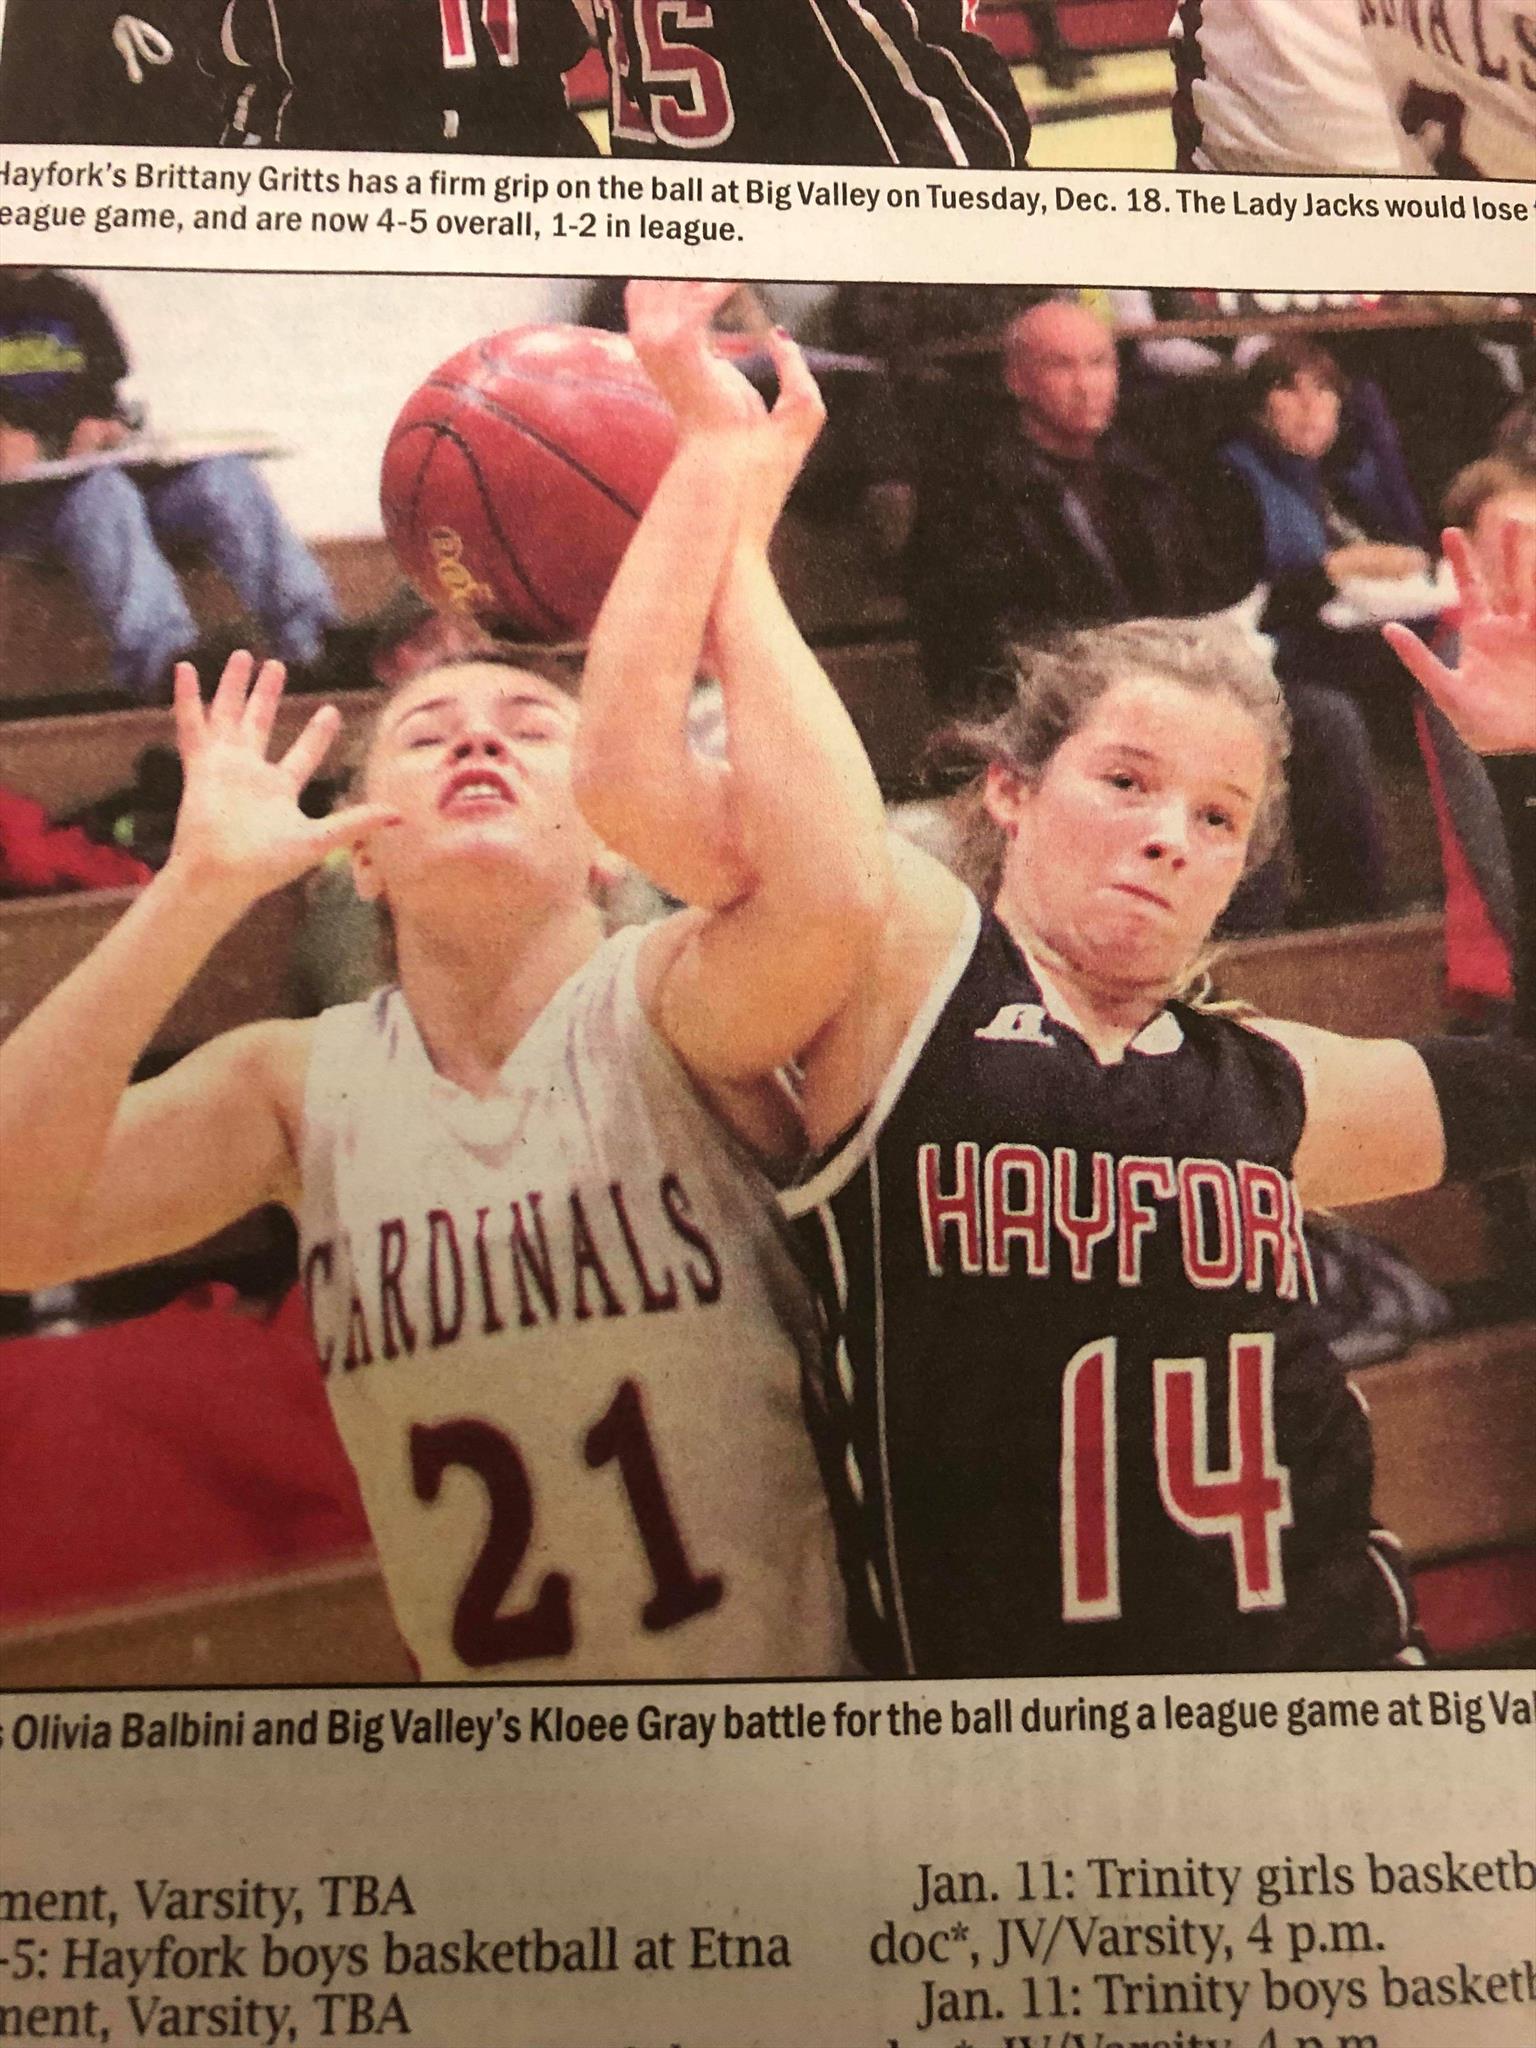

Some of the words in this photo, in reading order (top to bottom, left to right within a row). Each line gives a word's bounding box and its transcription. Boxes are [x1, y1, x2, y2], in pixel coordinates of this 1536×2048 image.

[135, 162, 252, 197] Brittany
[258, 165, 340, 193] Gritts
[348, 167, 399, 195] has
[405, 175, 422, 195] a
[429, 169, 486, 197] firm
[493, 172, 549, 204] grip
[556, 179, 591, 199] on
[597, 174, 644, 201] the
[651, 175, 703, 202] ball
[710, 180, 740, 204] at
[746, 179, 792, 212] Big
[796, 180, 881, 213] Valley
[886, 188, 920, 209] on
[925, 183, 1047, 217] Tuesday,
[1055, 186, 1117, 212] Dec.
[1127, 187, 1171, 213] 18.
[1175, 188, 1226, 215] The
[1232, 190, 1298, 223] Lady
[1302, 192, 1380, 218] Jacks
[1384, 194, 1467, 219] would
[1472, 195, 1529, 222] lose
[94, 204, 184, 234] game,
[193, 204, 247, 231] and
[255, 211, 303, 232] are
[311, 212, 369, 233] now
[376, 207, 428, 235] 4-5
[436, 211, 541, 241] overall,
[552, 212, 597, 238] 1-2
[606, 212, 631, 238] in
[640, 213, 744, 247] league.
[304, 1173, 722, 1373] CARDINALS
[1061, 1333, 1293, 1622] 14
[409, 1377, 723, 1667] 21
[11, 1712, 113, 1752] Olivia
[120, 1710, 245, 1750] Balbini
[251, 1709, 319, 1747] and
[327, 1708, 385, 1754] Big
[389, 1706, 522, 1753] Valley's
[529, 1706, 629, 1744] Kloee
[636, 1704, 717, 1750] Gray
[723, 1702, 827, 1740] battle
[831, 1701, 883, 1738] for
[885, 1700, 943, 1737] the
[950, 1697, 1013, 1736] ball
[1020, 1696, 1131, 1740] during
[1135, 1702, 1157, 1731] a
[1164, 1694, 1279, 1738] league
[1287, 1696, 1380, 1737] game
[1387, 1693, 1424, 1727] at
[1428, 1690, 1487, 1735] Big
[133, 1877, 304, 1930] Varsity,
[318, 1873, 417, 1918] TBA
[912, 1863, 1000, 1914] Jan.
[1015, 1859, 1075, 1902] 11:
[1086, 1857, 1242, 1907] Trinity
[1256, 1852, 1355, 1908] girls
[61, 1933, 248, 1990] Hayfork
[261, 1932, 369, 1988] boys
[383, 1925, 620, 1976] basketball
[633, 1931, 677, 1972] at
[689, 1926, 793, 1971] Etna
[992, 1914, 1233, 1969] JV/Varsity,
[1246, 1912, 1274, 1955] 4
[1286, 1920, 1386, 1964] p.m.
[126, 1994, 297, 2047] Varsity,
[311, 1991, 413, 2037] TBA
[915, 1979, 1005, 2033] Jan.
[1021, 1975, 1081, 2020] 11:
[1092, 1971, 1251, 2023] Trinity
[1260, 1967, 1368, 2021] boys
